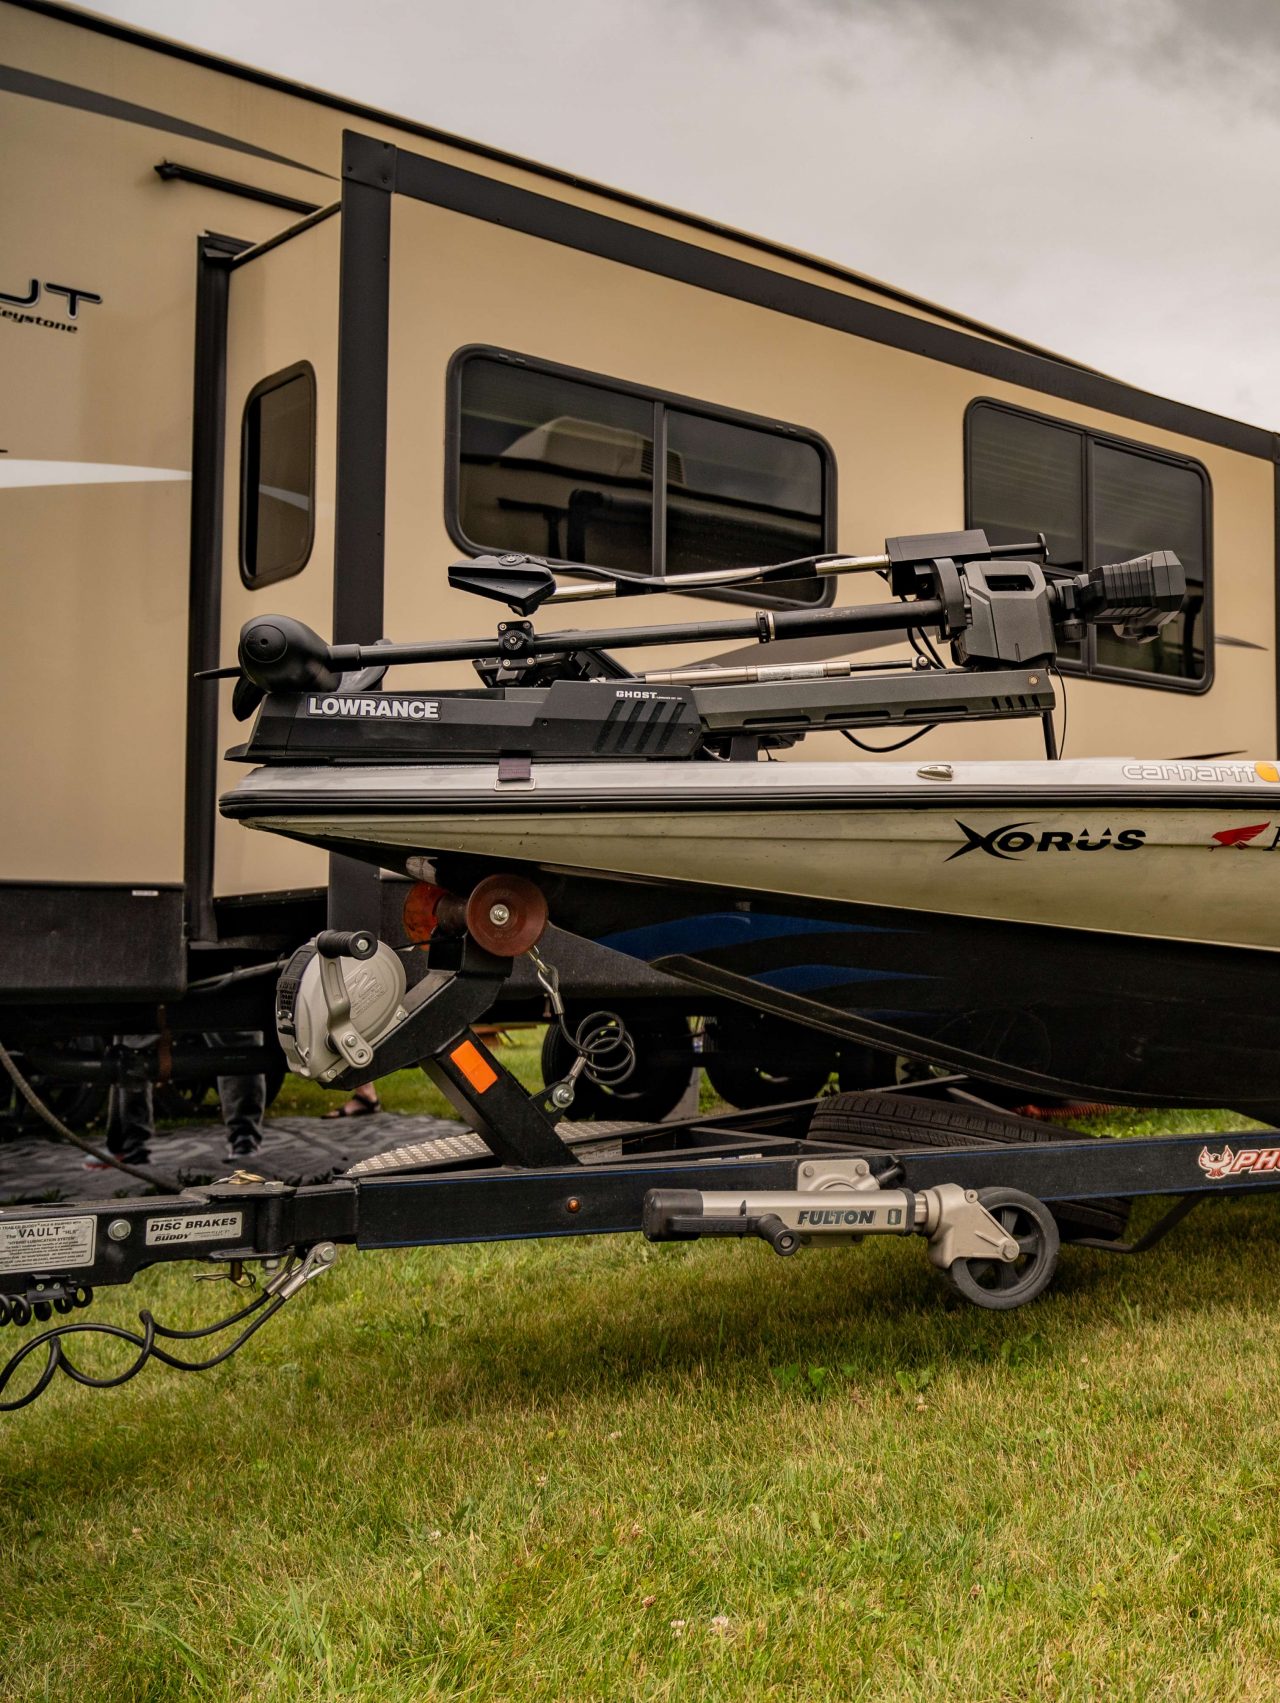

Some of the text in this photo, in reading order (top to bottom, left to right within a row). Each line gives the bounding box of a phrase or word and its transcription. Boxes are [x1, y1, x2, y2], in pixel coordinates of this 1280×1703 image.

[0, 307, 78, 334] eystone
[616, 690, 658, 699] GHOST
[309, 697, 439, 720] LOWRANCE
[1122, 763, 1257, 783] carhartt
[150, 1222, 182, 1232] DISC
[185, 1217, 238, 1229] BRAKES
[797, 1209, 877, 1226] FULTON
[19, 1226, 62, 1238] VAULT
[154, 1233, 189, 1242] BUDDY
